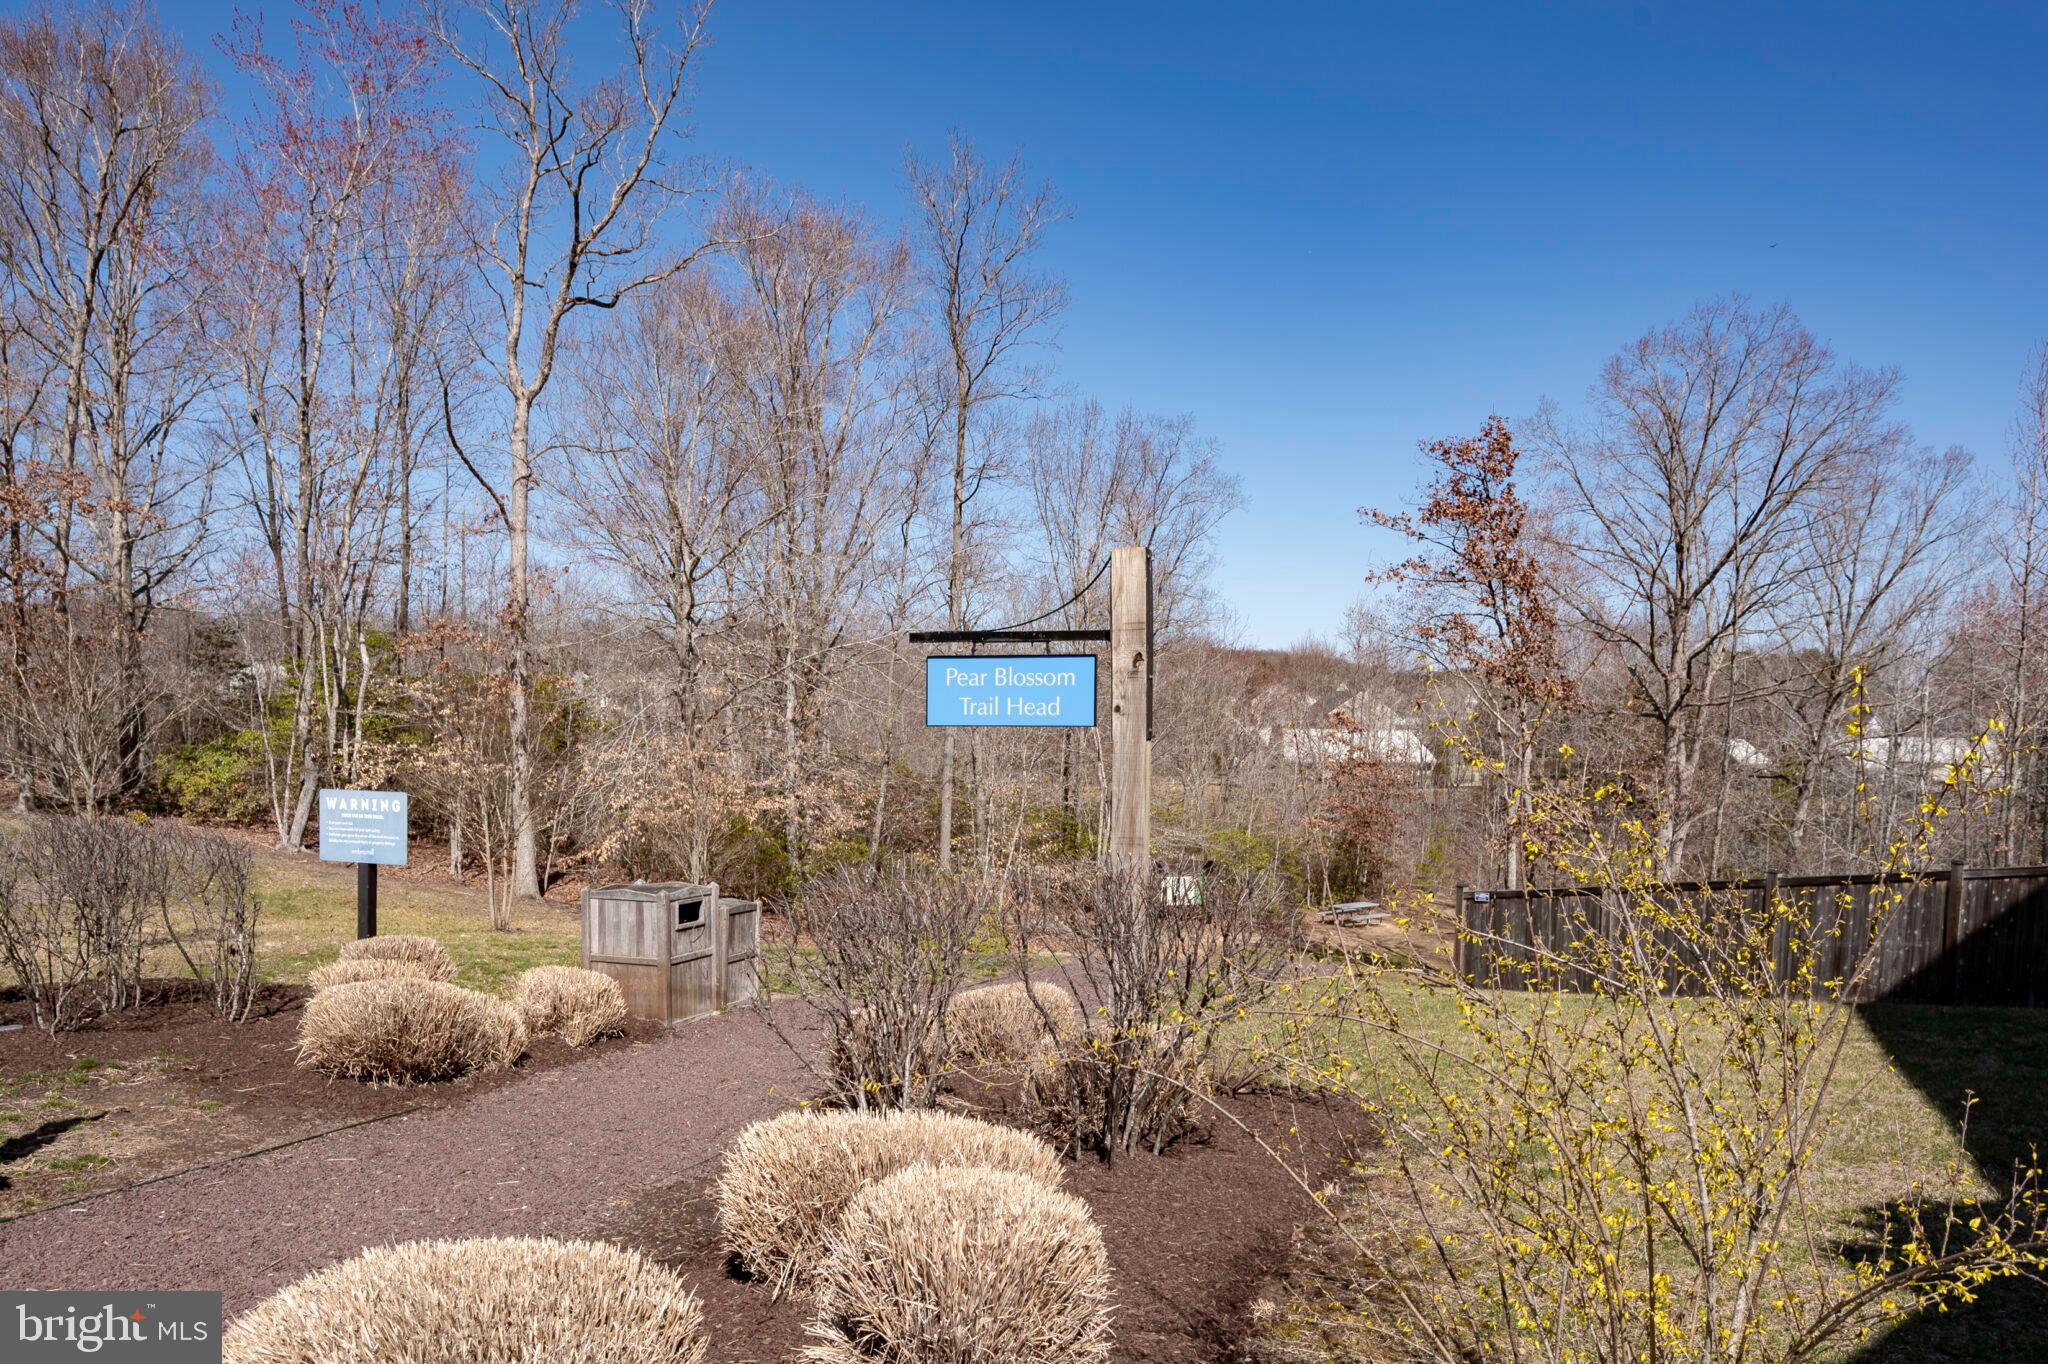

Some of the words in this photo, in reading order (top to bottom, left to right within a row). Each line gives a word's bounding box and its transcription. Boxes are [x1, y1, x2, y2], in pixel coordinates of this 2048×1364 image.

[945, 667, 988, 687] Pear
[994, 665, 1076, 687] Blossom
[959, 695, 999, 716] Trail
[1006, 695, 1061, 716] Head
[325, 796, 401, 813] WARNING
